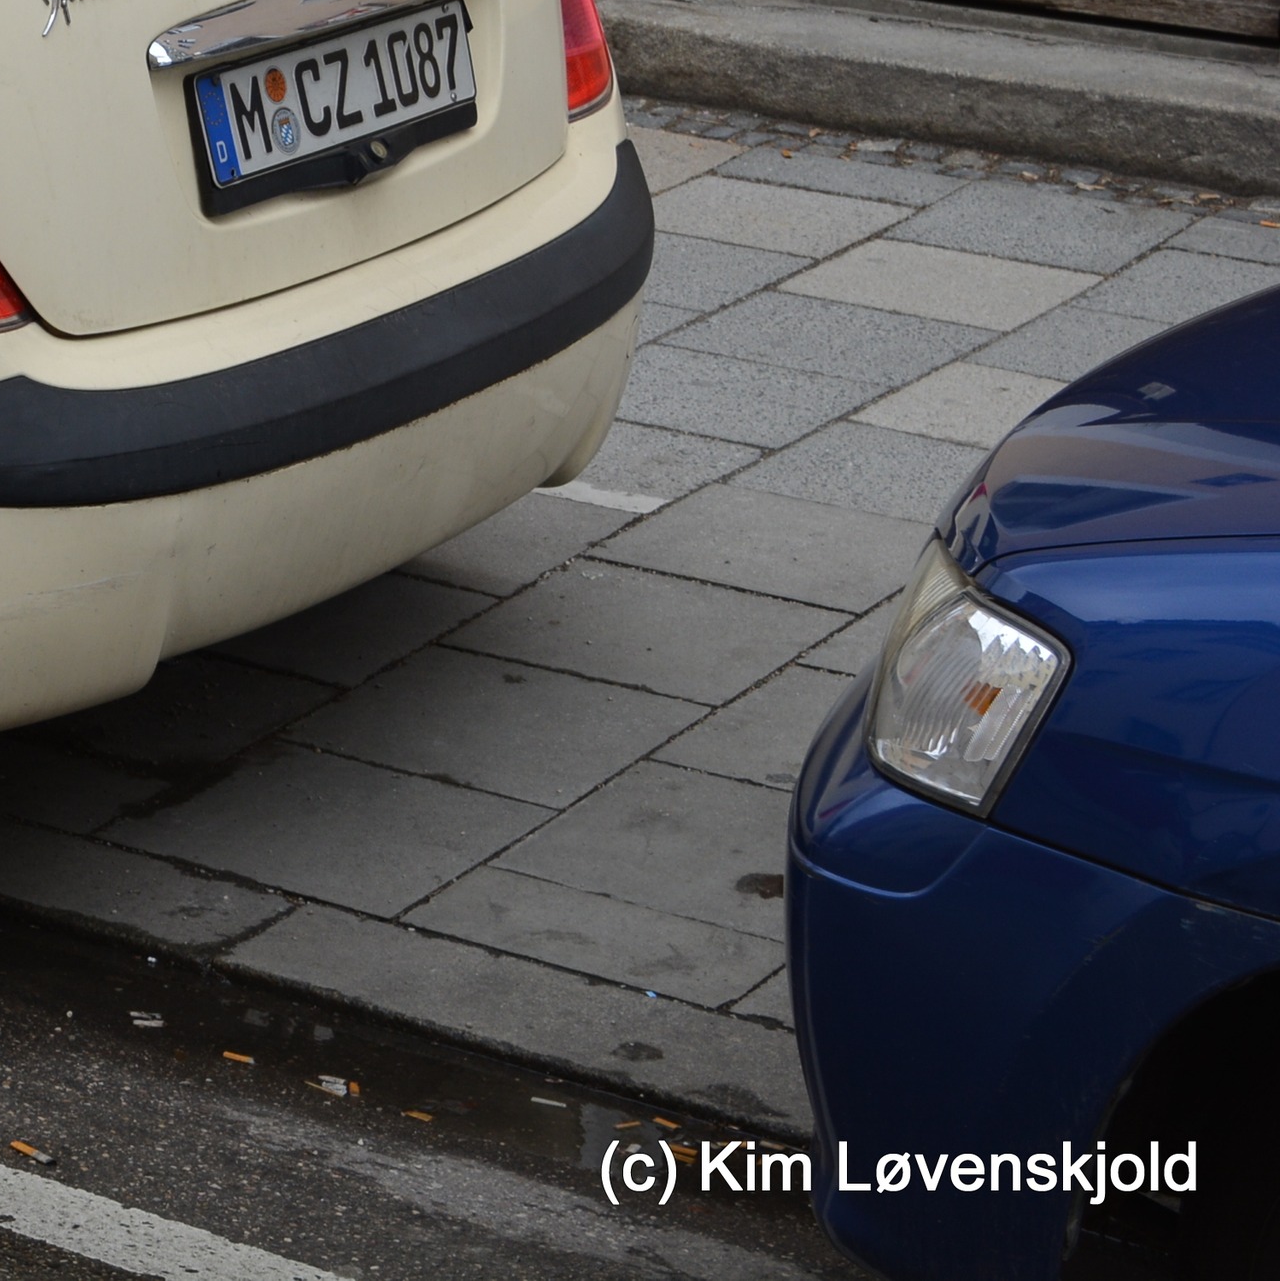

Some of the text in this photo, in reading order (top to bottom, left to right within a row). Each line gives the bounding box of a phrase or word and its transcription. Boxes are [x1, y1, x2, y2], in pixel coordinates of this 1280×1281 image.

[216, 140, 228, 163] D
[229, 75, 273, 160] M
[363, 13, 458, 118] 1087
